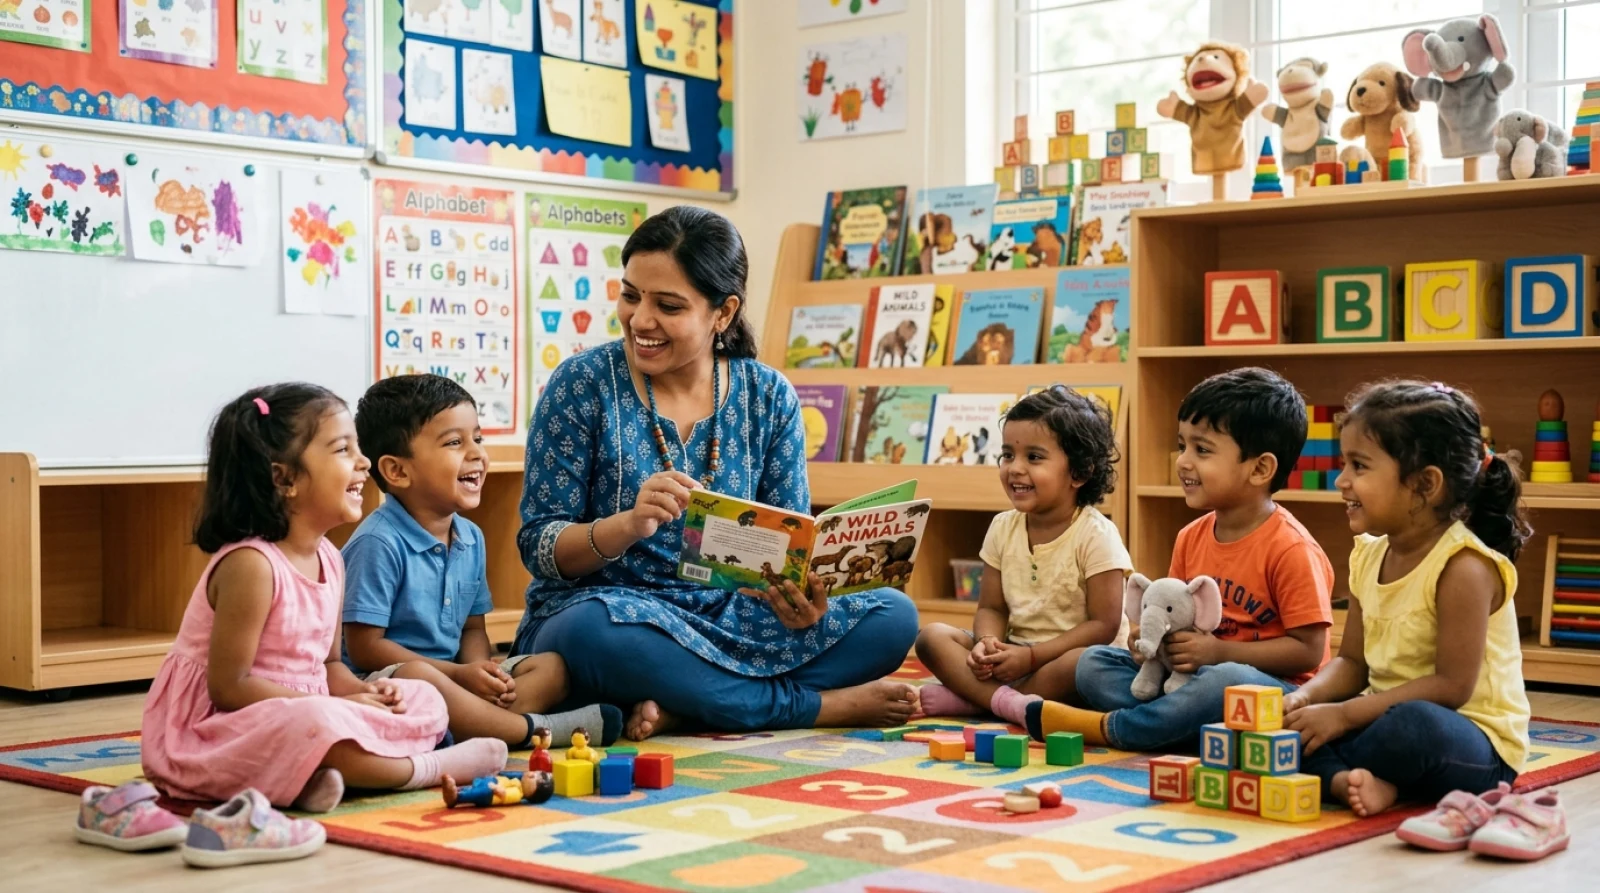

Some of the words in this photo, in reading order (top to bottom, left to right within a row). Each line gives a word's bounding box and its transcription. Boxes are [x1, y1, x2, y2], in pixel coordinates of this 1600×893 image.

[249, 8, 262, 24] u
[275, 19, 287, 34] v
[249, 38, 261, 60] y
[1007, 146, 1018, 160] A
[1024, 168, 1035, 184] B
[405, 190, 487, 214] Alphabet
[548, 204, 627, 226] Alphabets
[385, 226, 398, 244] A
[430, 229, 442, 247] B
[385, 260, 396, 278] E
[474, 266, 487, 283] H
[893, 290, 918, 300] WILD
[1334, 281, 1373, 331] B
[1420, 274, 1463, 330] C
[1520, 271, 1569, 326] D
[474, 298, 488, 316] O
[882, 301, 926, 313] ANIMALS
[1217, 284, 1265, 334] A
[385, 329, 400, 349] Q
[431, 331, 443, 349] R
[475, 332, 486, 349] T
[474, 366, 487, 384] X
[847, 510, 898, 528] WILD
[823, 520, 916, 546] ANIMALS
[1231, 698, 1251, 723] A
[1208, 736, 1225, 761] B
[1249, 742, 1266, 768] B
[1278, 743, 1294, 766] B
[1157, 771, 1179, 793] A
[1203, 775, 1221, 800] B
[1236, 781, 1254, 806] C
[1270, 791, 1286, 812] D
[669, 803, 798, 829] 2
[822, 826, 957, 855] 2
[983, 851, 1133, 883] 2
